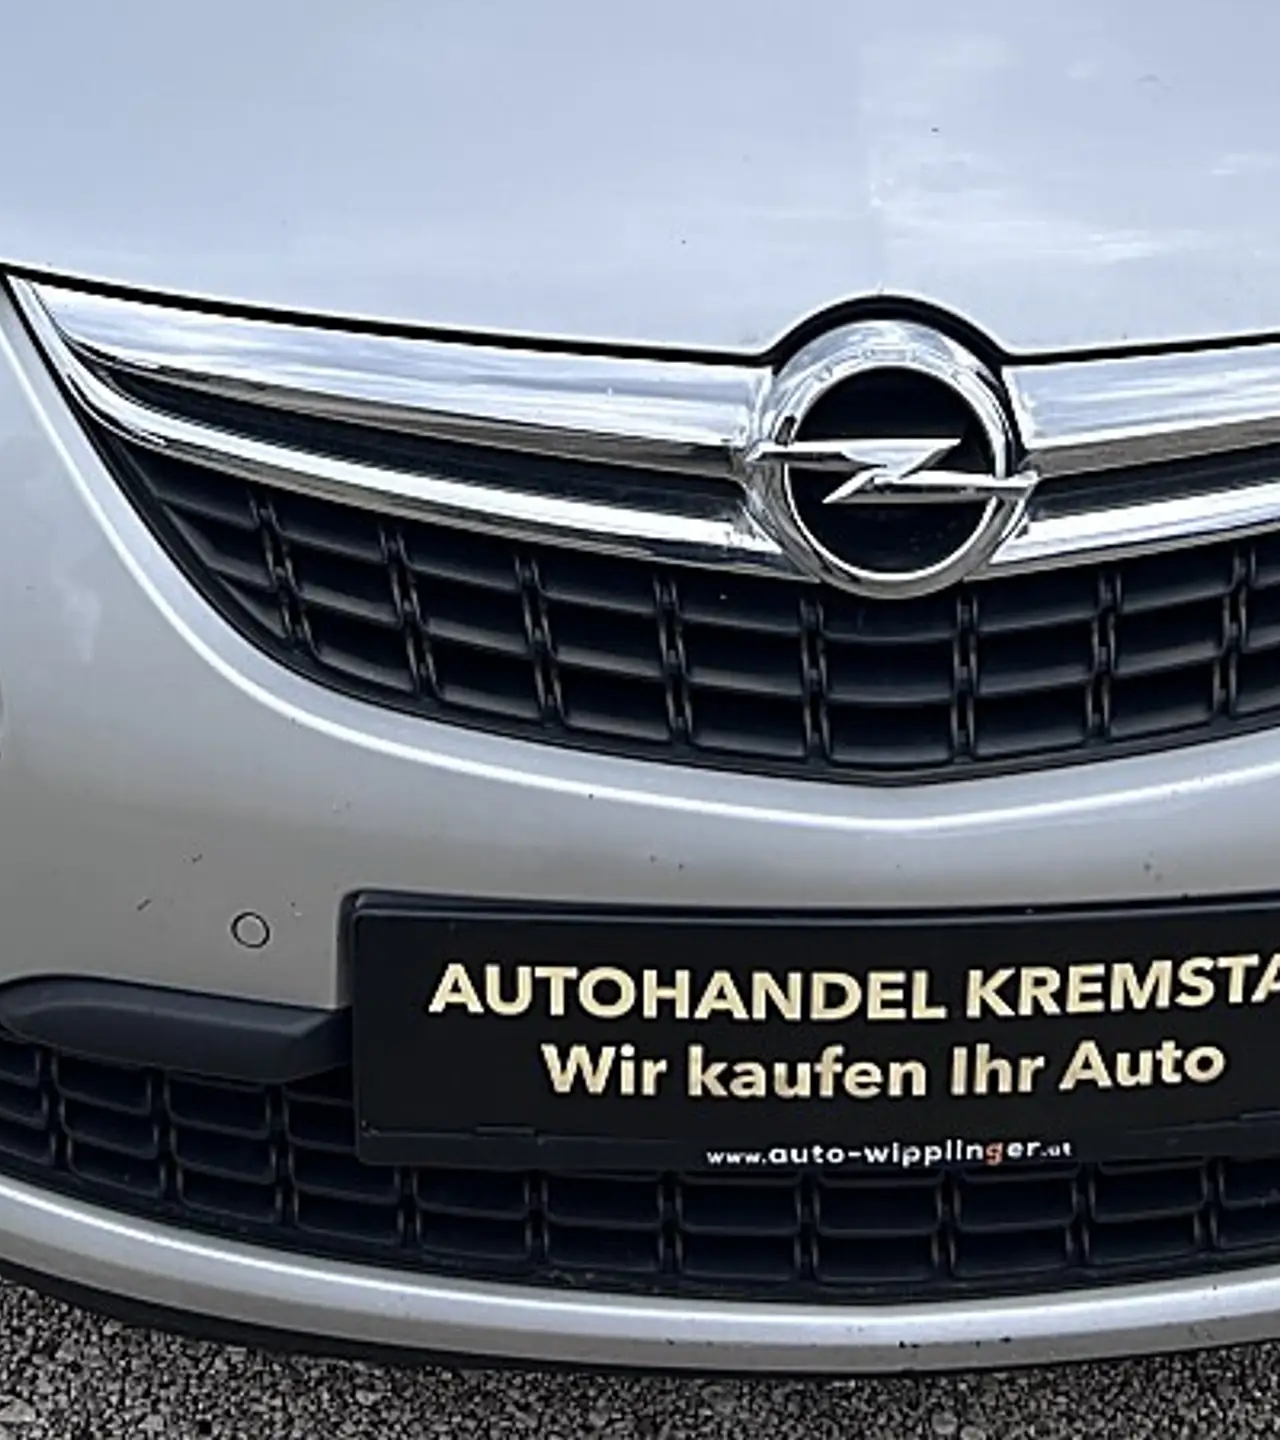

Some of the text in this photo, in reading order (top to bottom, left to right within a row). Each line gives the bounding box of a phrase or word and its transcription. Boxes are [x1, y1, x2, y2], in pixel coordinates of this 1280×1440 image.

[427, 962, 948, 1022] AUTOHANDEL
[540, 1039, 1226, 1099] Wir kaufen Ihr Auto
[706, 1137, 1072, 1168] www.auto-wipplinger.at
